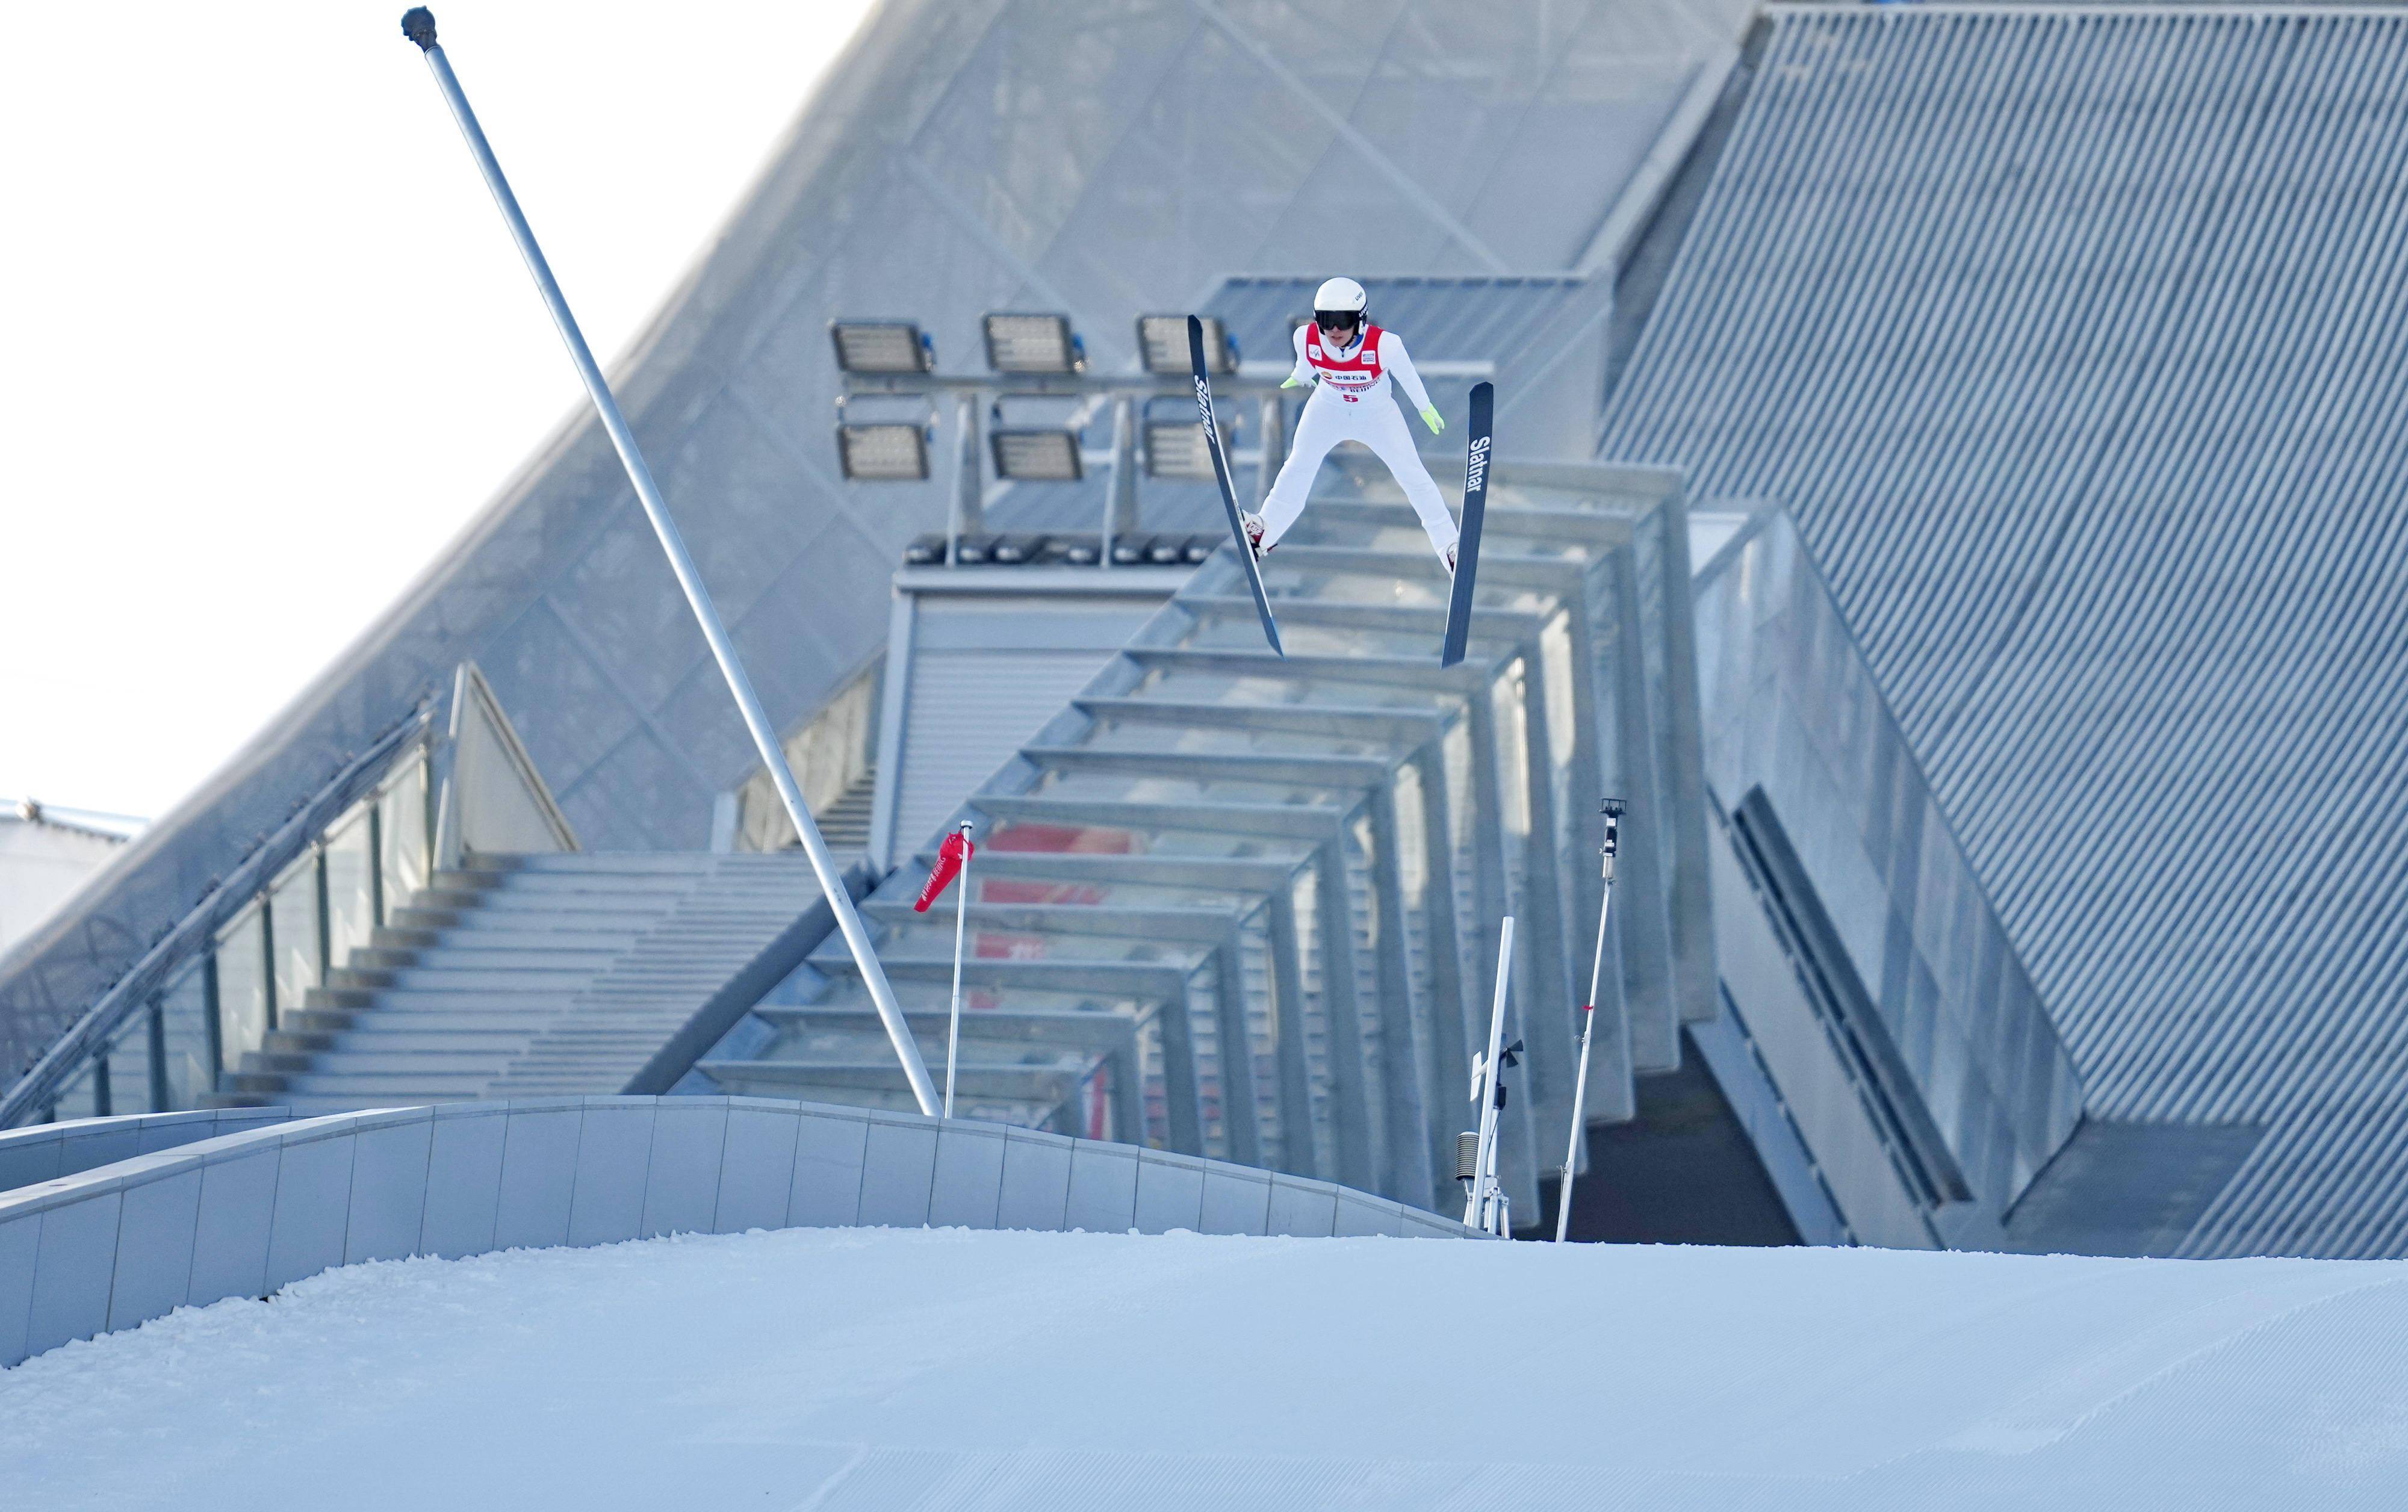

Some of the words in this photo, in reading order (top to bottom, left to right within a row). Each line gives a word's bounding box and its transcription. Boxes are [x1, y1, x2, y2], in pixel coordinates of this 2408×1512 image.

[1194, 374, 1215, 445] Slatnar
[1343, 394, 1358, 403] 5
[1466, 436, 1491, 493] Slatnar
